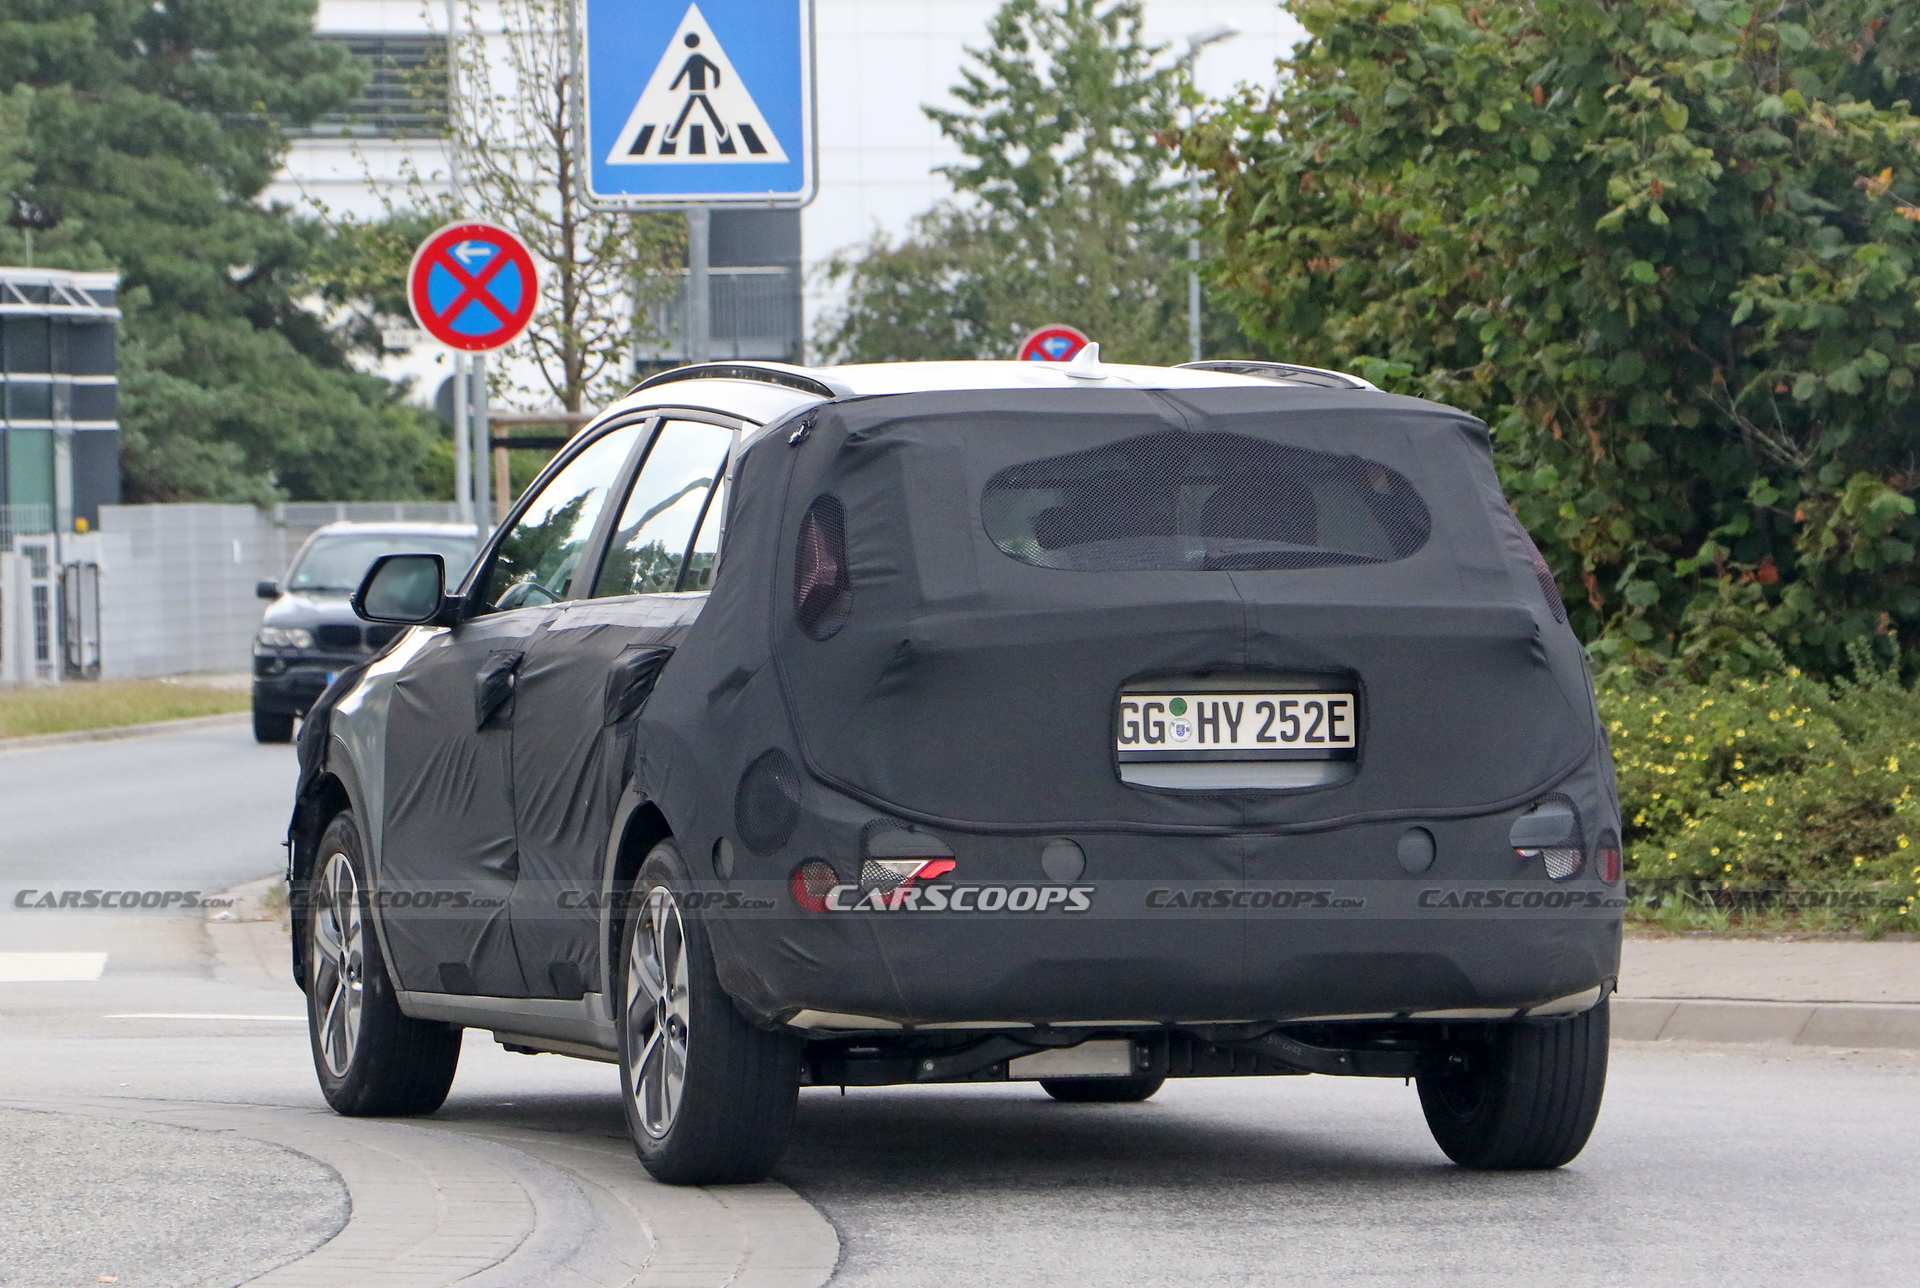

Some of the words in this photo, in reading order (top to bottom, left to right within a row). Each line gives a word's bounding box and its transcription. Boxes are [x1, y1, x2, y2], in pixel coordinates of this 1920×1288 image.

[1118, 702, 1165, 743] GG
[1197, 701, 1244, 743] HY
[1256, 700, 1350, 742] 252E
